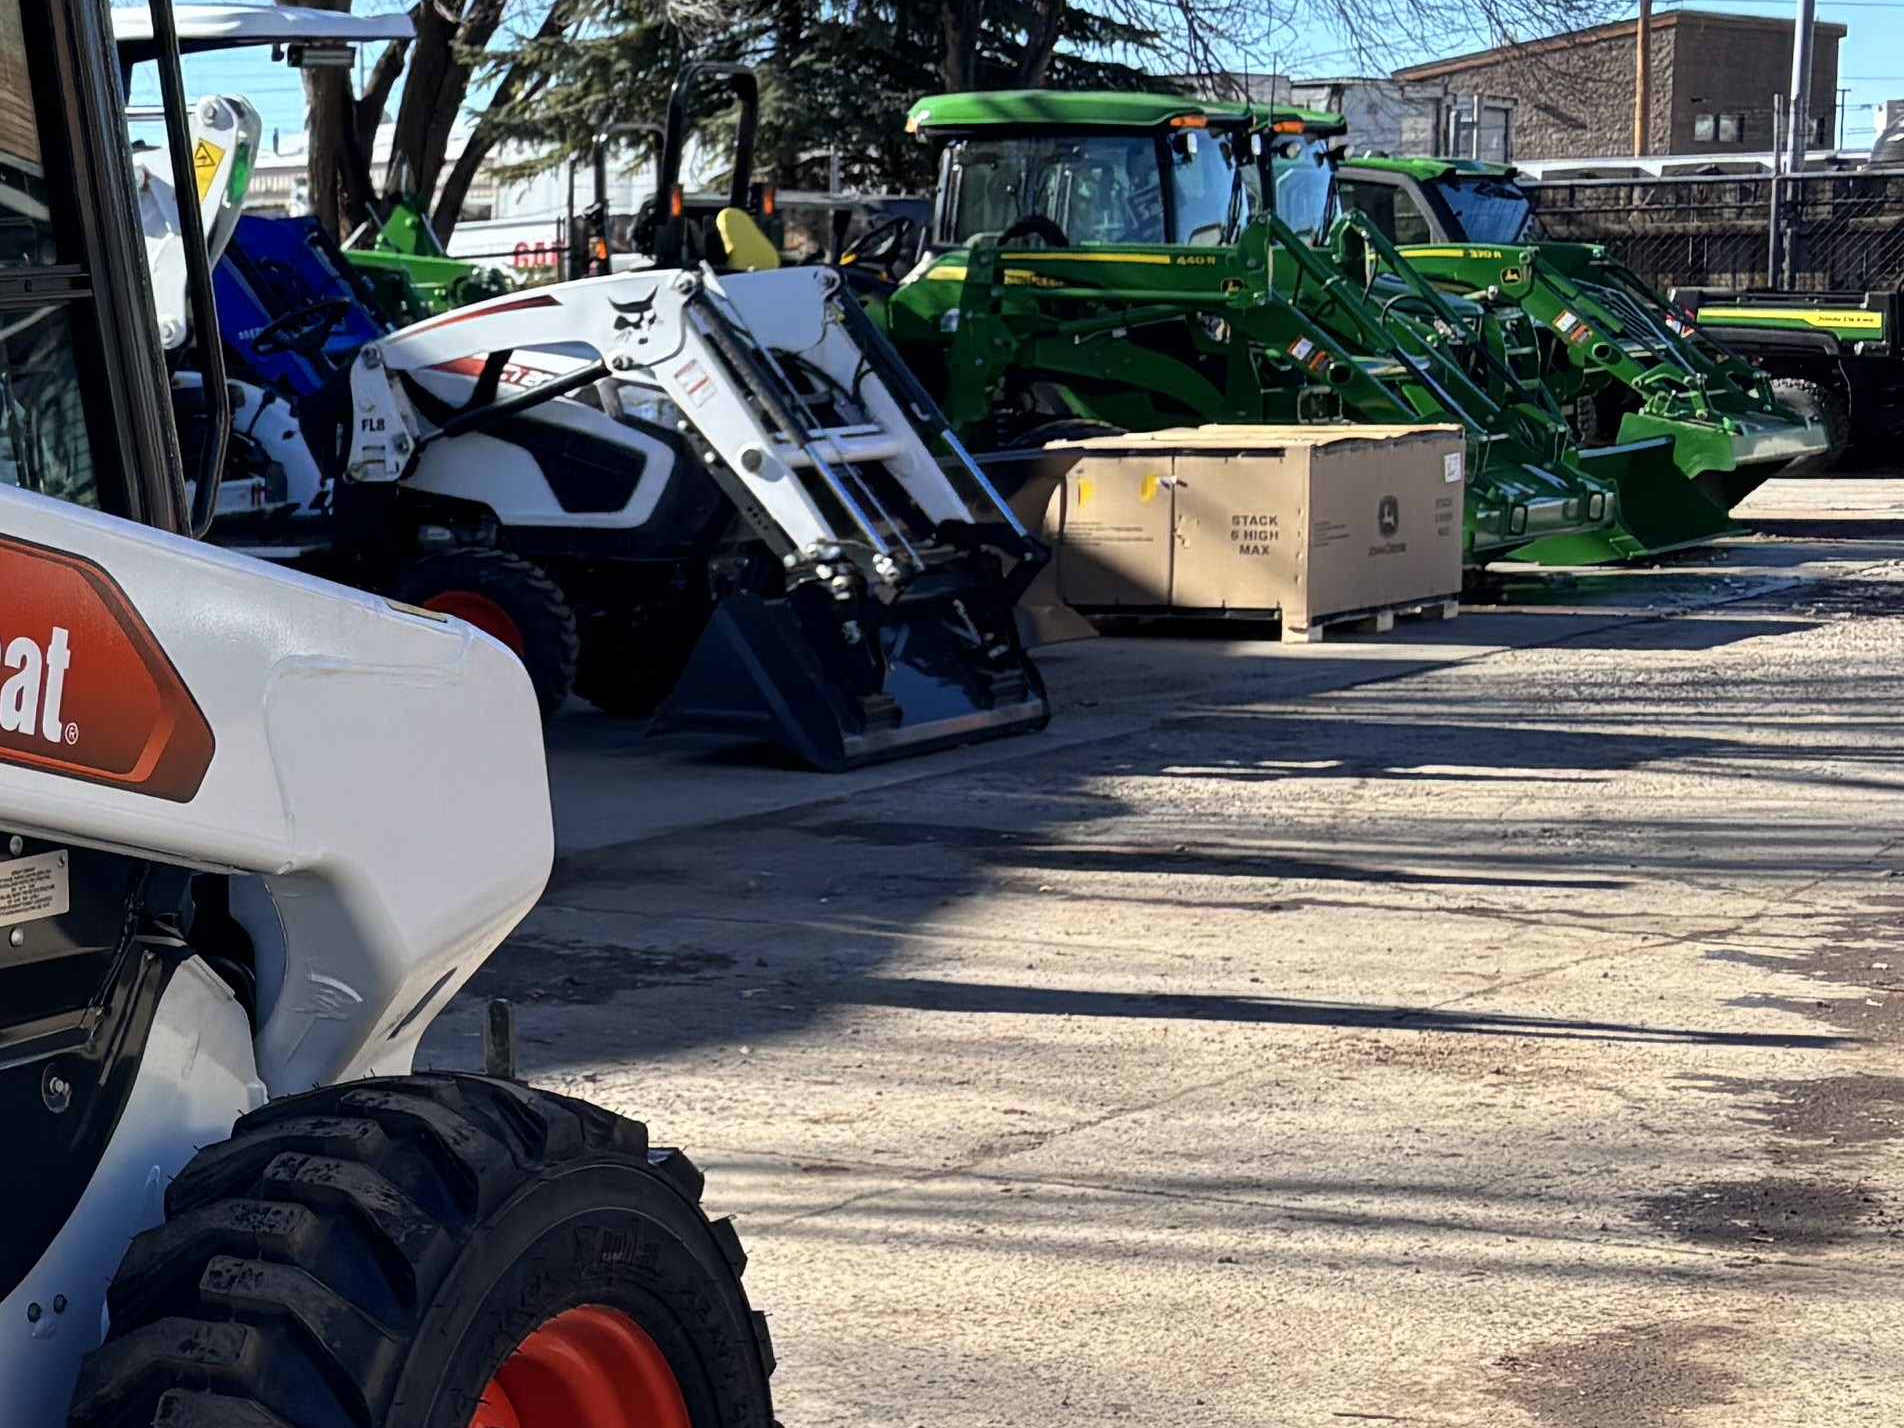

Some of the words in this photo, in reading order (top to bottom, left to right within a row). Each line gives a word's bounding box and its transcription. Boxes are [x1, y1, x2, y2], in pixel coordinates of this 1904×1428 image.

[361, 418, 386, 432] FL8
[1231, 514, 1279, 527] STACK
[1243, 530, 1280, 542] HIGH
[1238, 544, 1270, 557] MAX
